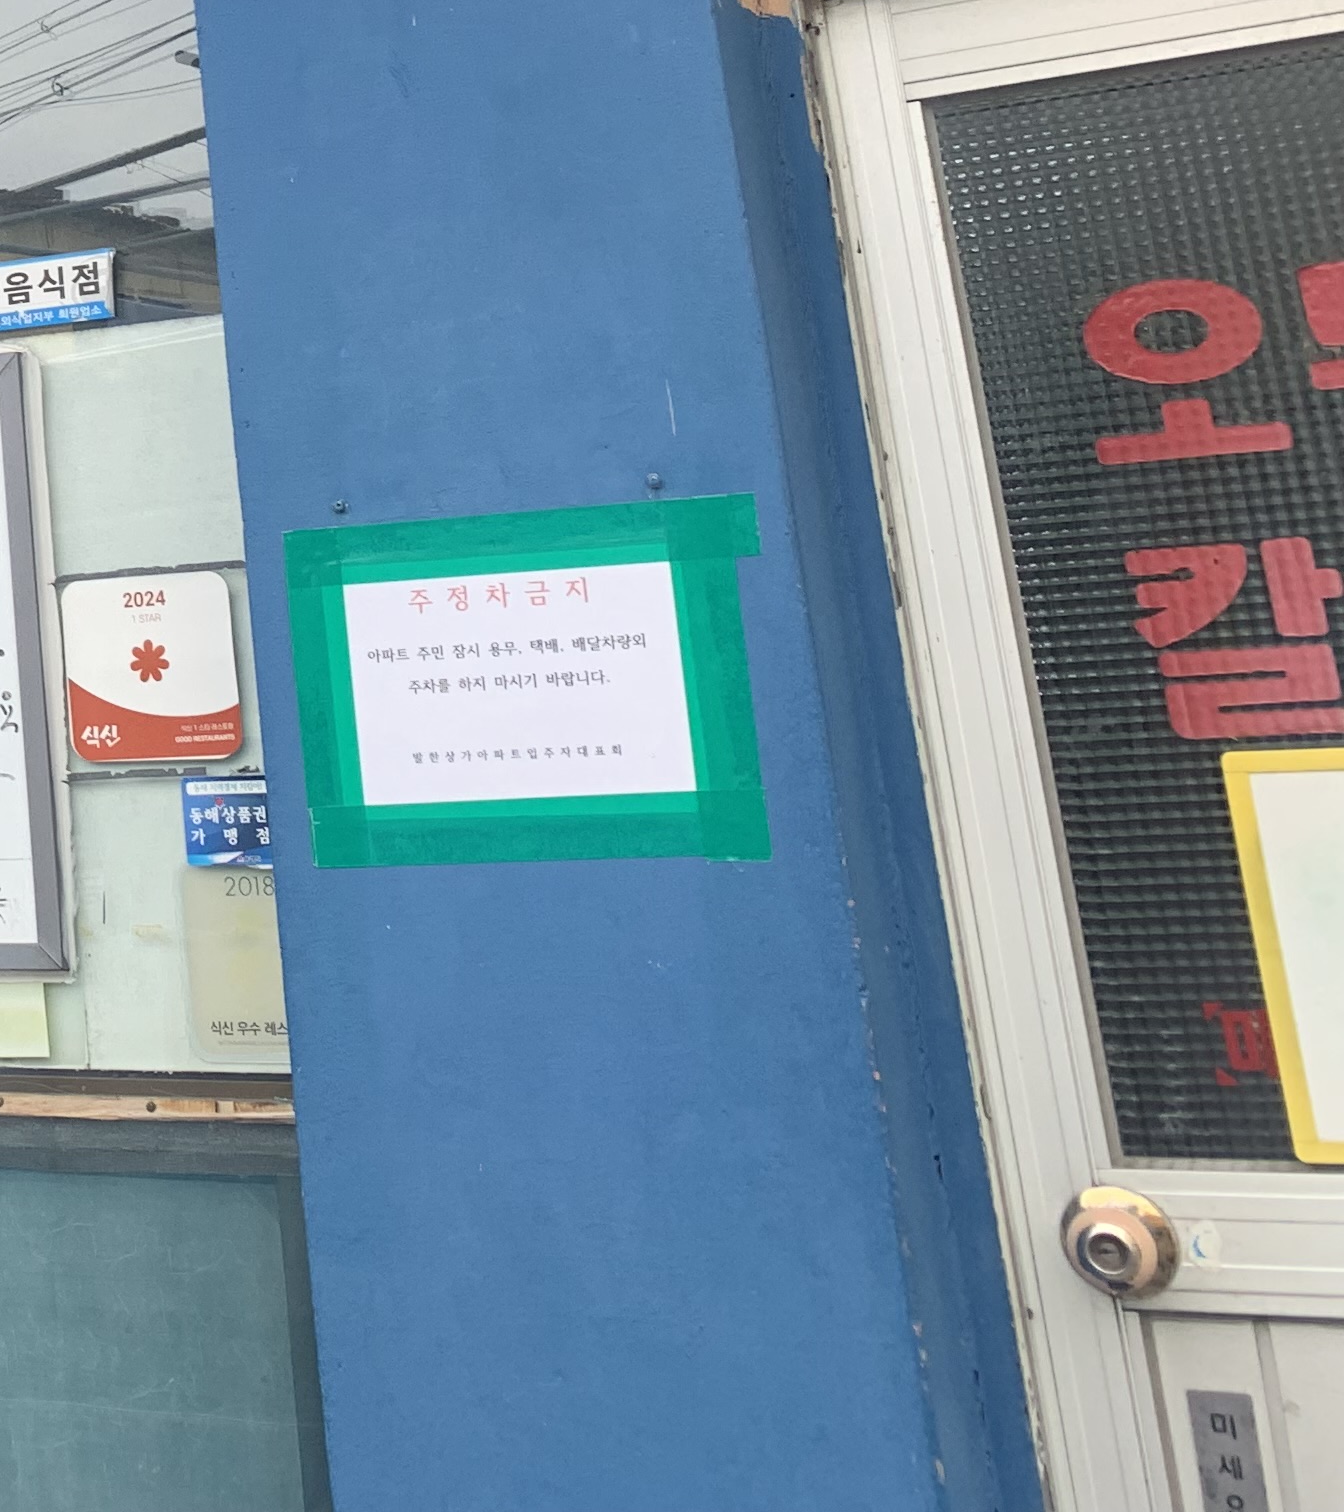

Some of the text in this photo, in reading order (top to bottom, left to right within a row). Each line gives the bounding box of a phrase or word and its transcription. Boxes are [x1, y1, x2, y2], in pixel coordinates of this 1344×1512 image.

[122, 590, 166, 608] 2024
[138, 613, 162, 624] STAR
[367, 646, 410, 664] 아파트
[417, 644, 445, 661] 주민
[451, 642, 480, 659] 잠시
[571, 633, 647, 652] 배달차량외
[408, 669, 611, 695] 주차를 하지 마시기 바랍니다.
[80, 725, 121, 748] 식신
[190, 805, 267, 825] 동해상품권
[224, 875, 275, 897] 2018
[211, 1021, 234, 1036] 식신
[237, 1021, 261, 1036] 우수
